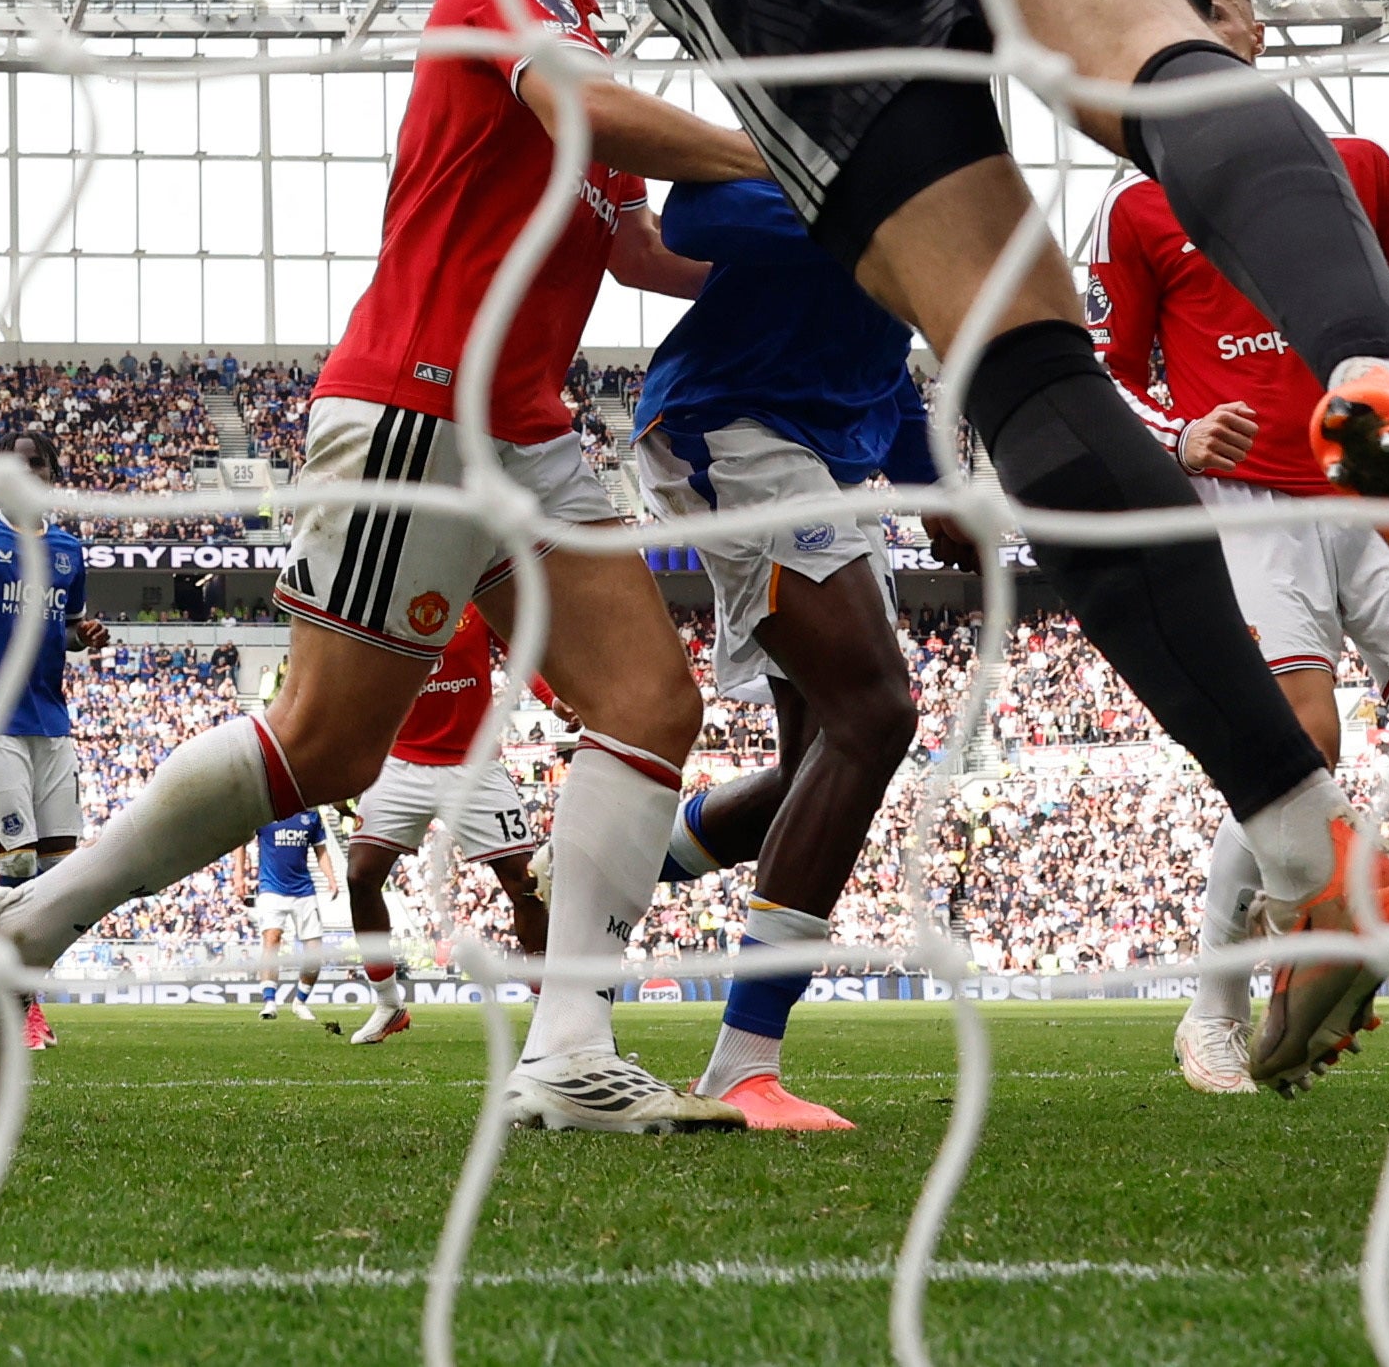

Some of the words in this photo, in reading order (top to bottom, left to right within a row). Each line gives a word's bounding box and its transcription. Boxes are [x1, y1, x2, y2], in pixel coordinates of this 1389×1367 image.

[233, 465, 253, 480] 235
[171, 545, 249, 569] FOR
[2, 603, 65, 622] MARETS
[288, 828, 309, 841] CMC
[495, 809, 528, 842] 13
[417, 982, 534, 1004] MOR
[643, 991, 679, 1001] PEPSI
[804, 976, 880, 1002] PSI
